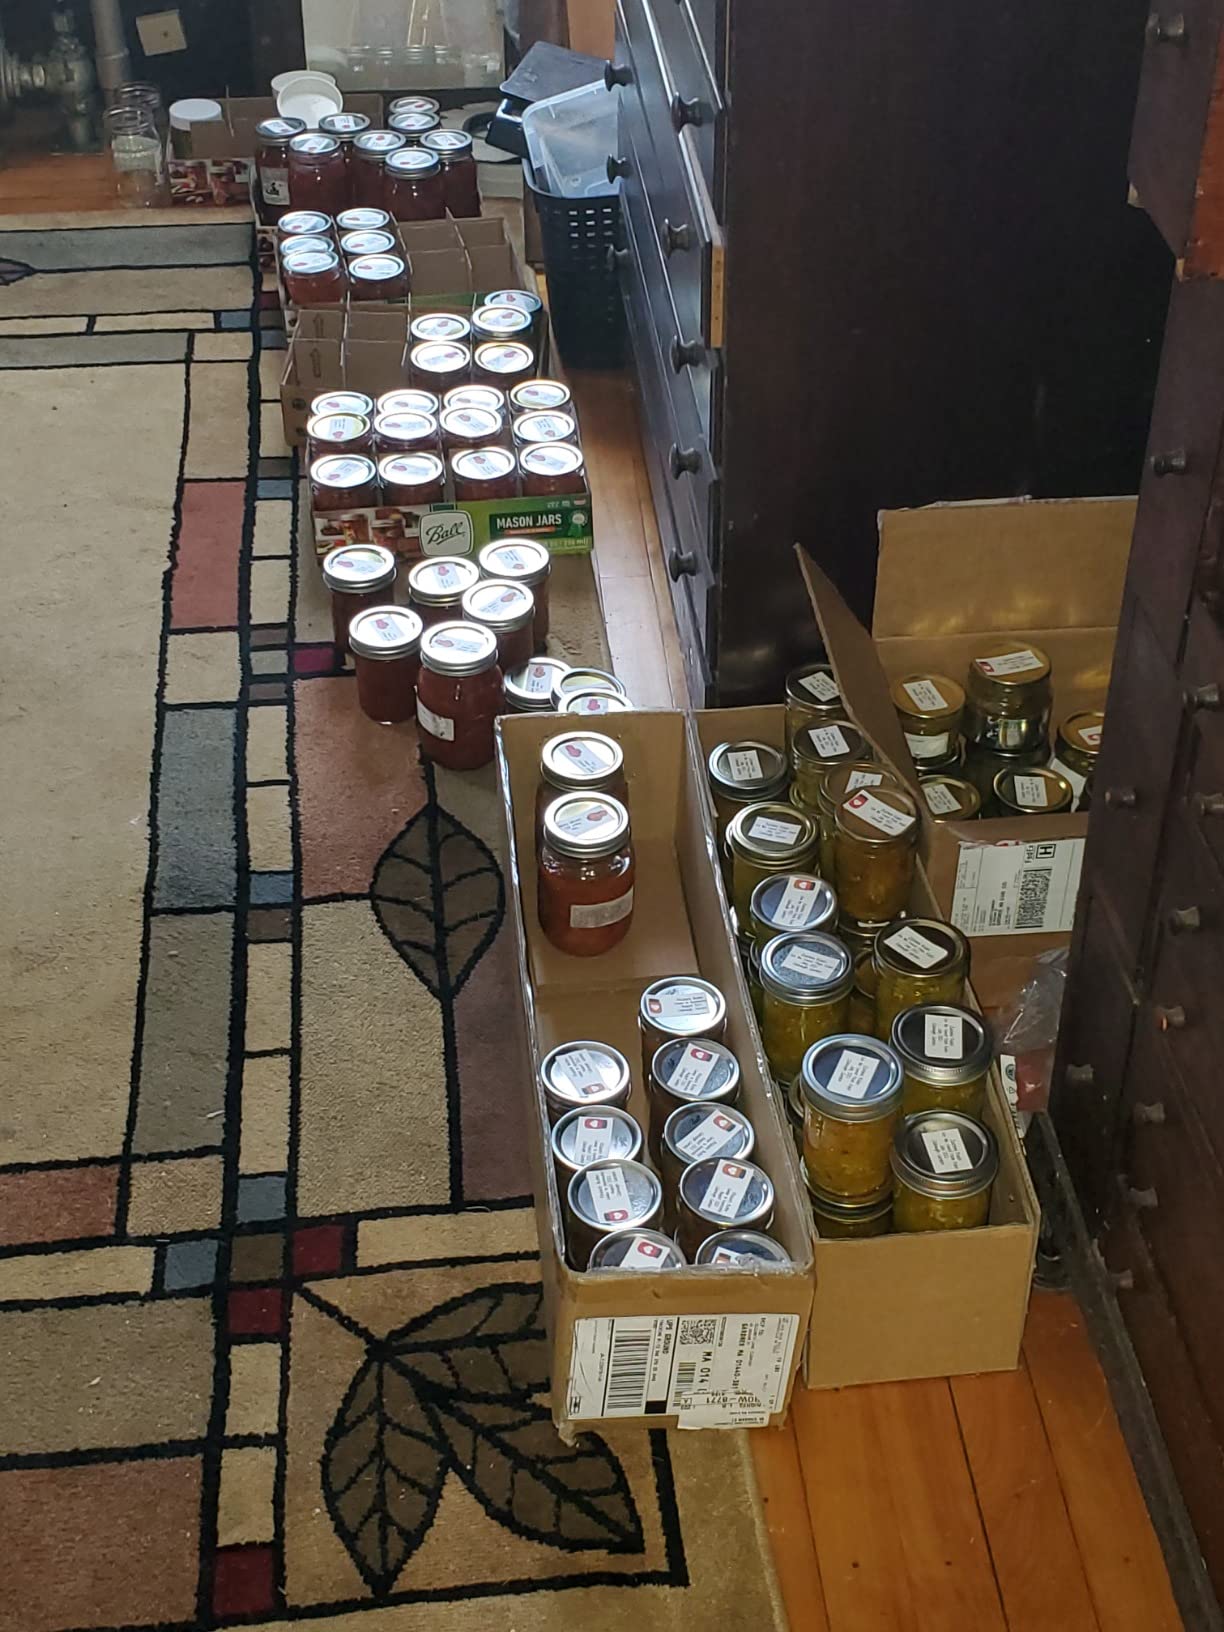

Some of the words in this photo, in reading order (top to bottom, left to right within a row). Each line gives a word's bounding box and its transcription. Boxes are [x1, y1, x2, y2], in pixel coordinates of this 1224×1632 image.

[496, 515, 533, 529] MASON
[536, 514, 562, 526] JARS
[426, 522, 466, 545] Ball
[701, 1351, 712, 1362] MA
[698, 1367, 711, 1383] 014
